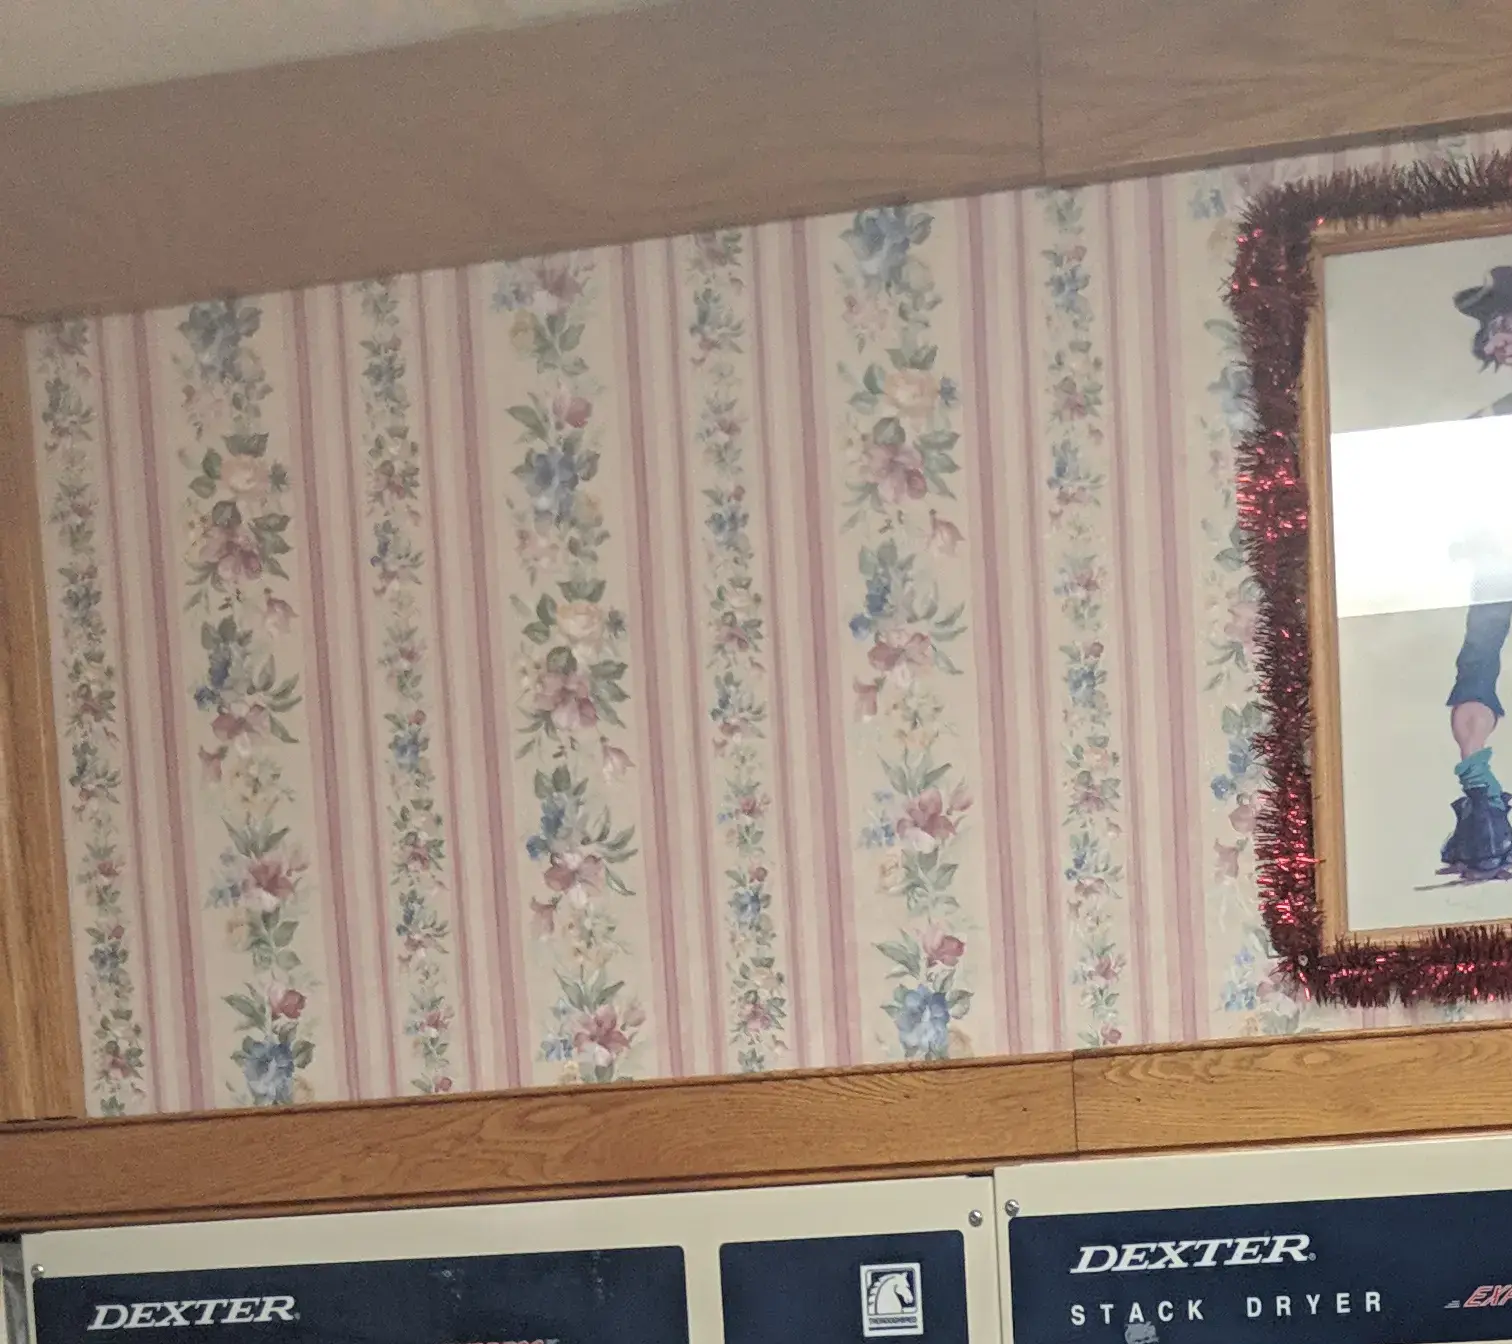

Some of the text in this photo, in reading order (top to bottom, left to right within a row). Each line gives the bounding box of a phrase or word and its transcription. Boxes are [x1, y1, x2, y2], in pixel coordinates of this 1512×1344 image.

[1069, 1233, 1313, 1274] DEXTER
[86, 1295, 298, 1331] DEXTER
[1070, 1290, 1381, 1326] STACK DRYER
